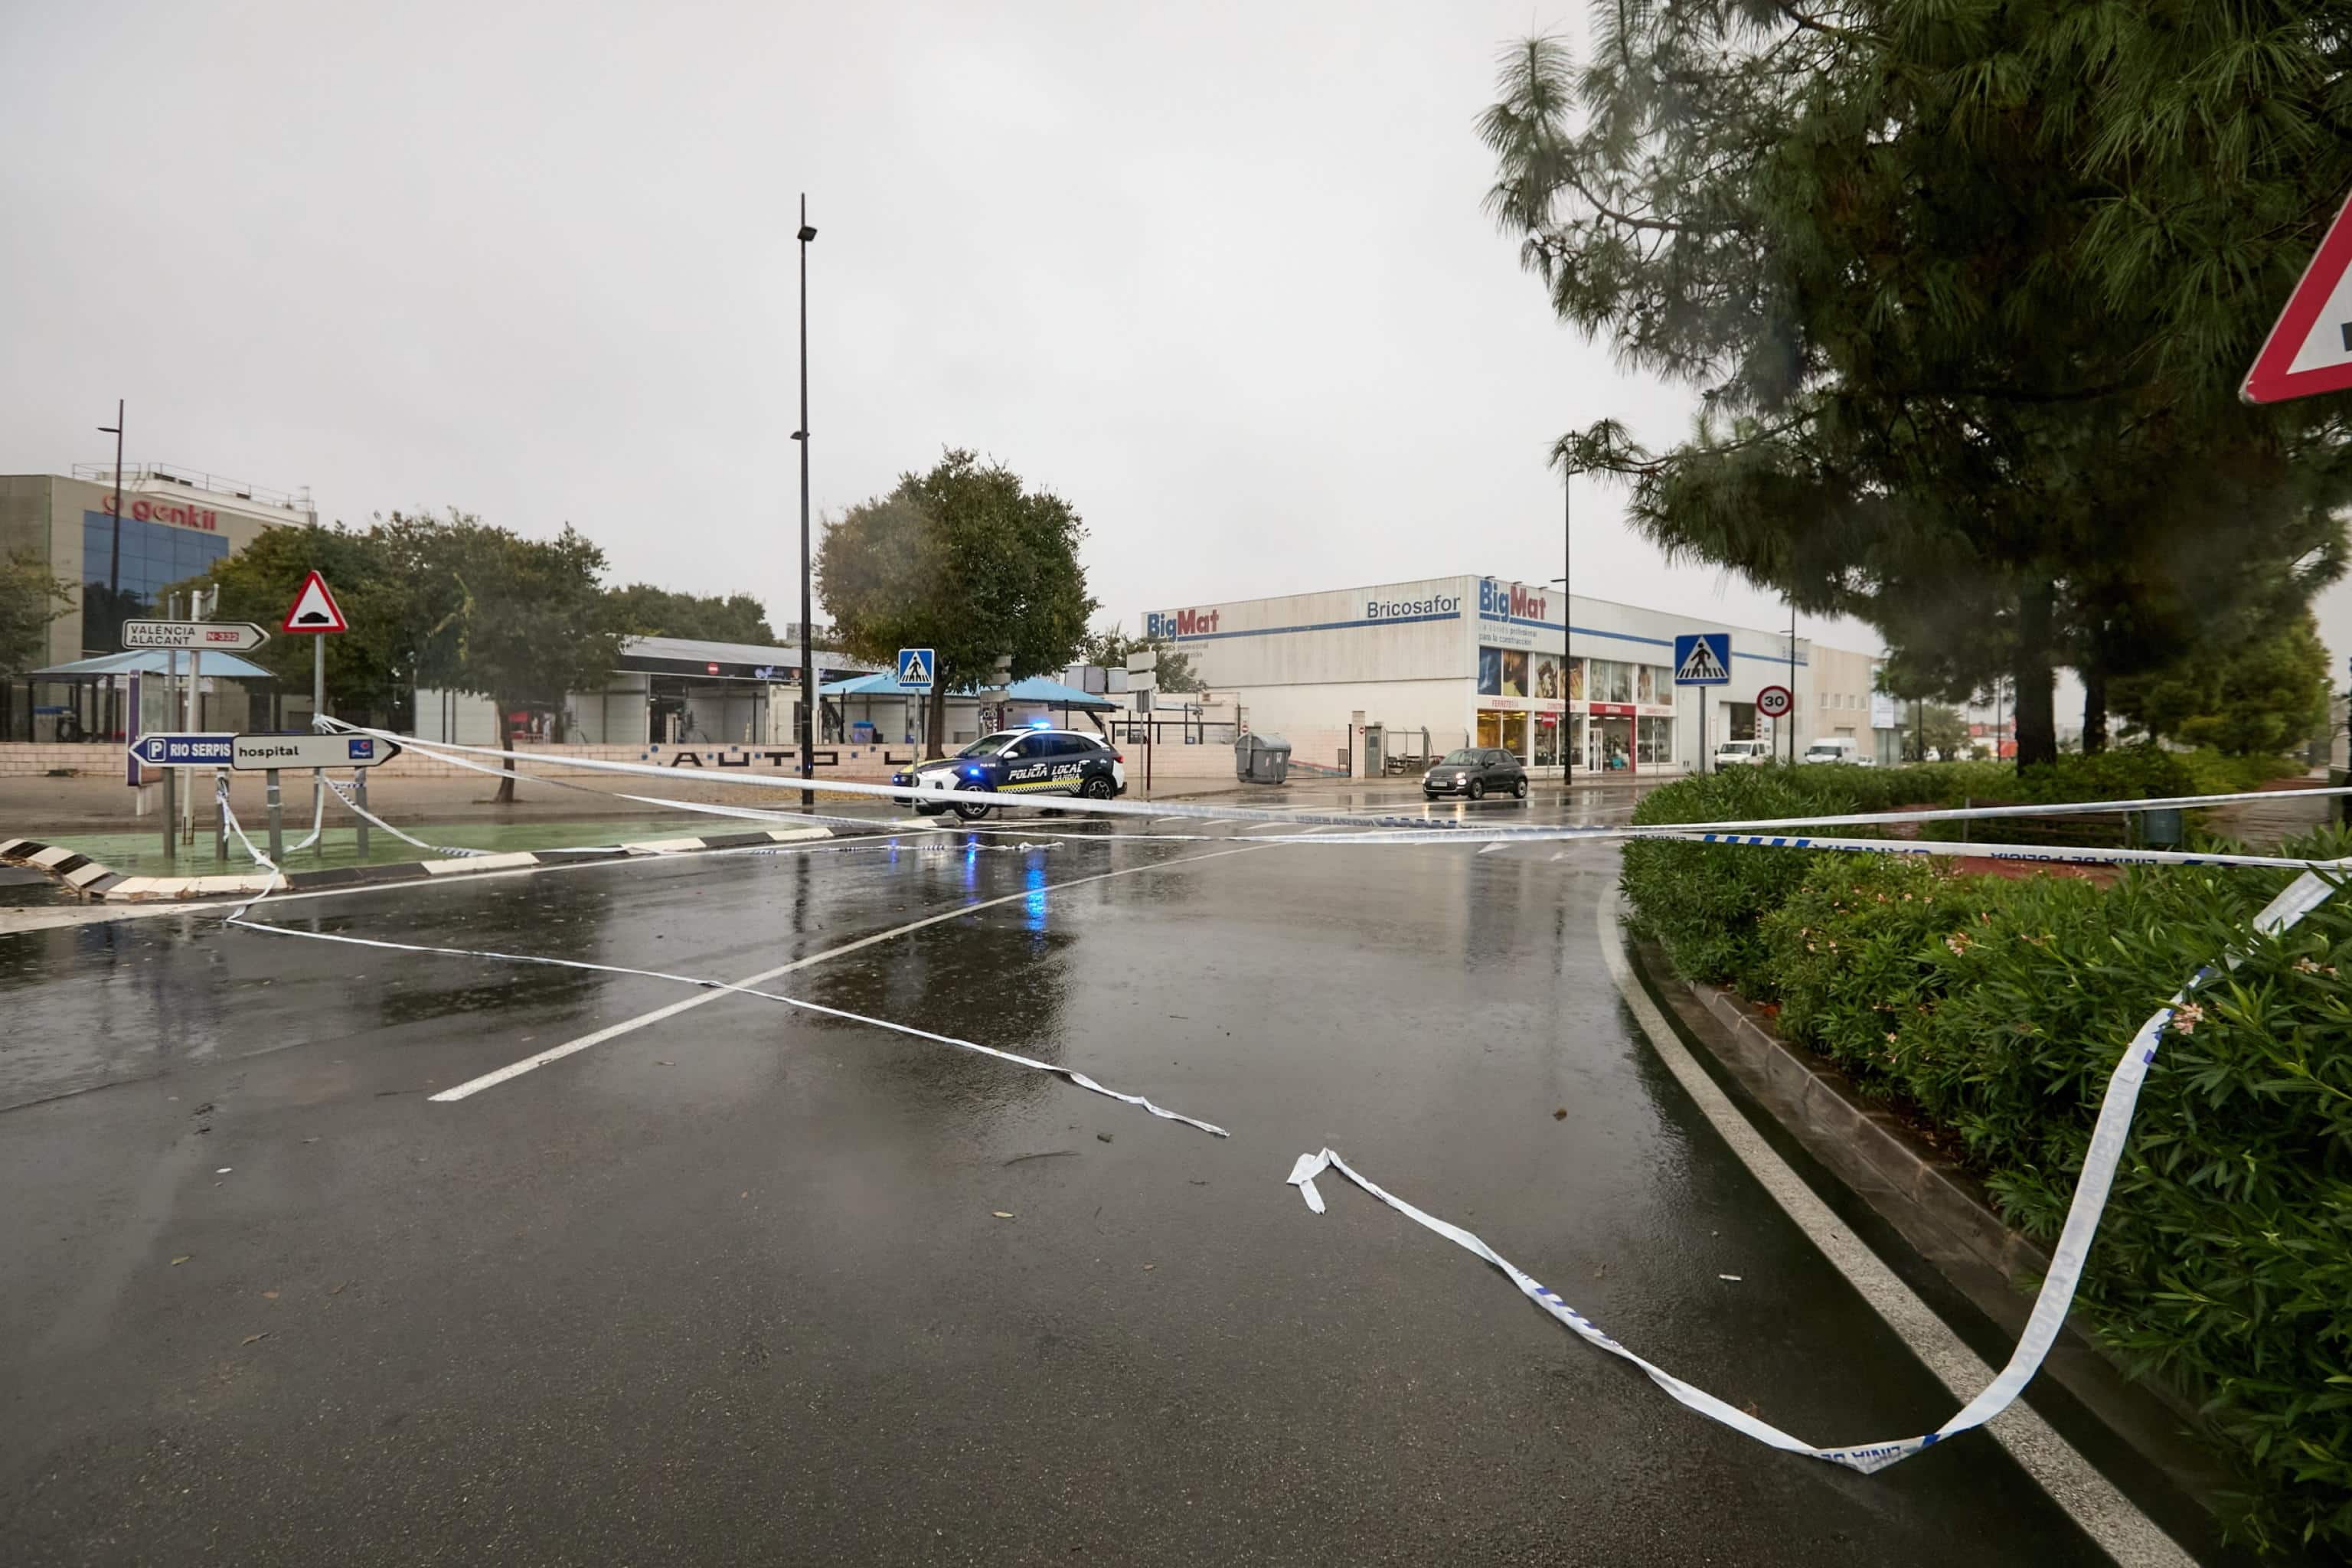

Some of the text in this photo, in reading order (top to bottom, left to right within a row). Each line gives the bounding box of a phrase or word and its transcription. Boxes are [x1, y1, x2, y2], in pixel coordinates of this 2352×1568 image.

[1367, 595, 1461, 618] Bricosafor
[1479, 580, 1546, 622] BigMat
[130, 624, 195, 635] VALÈNCIA
[1147, 609, 1219, 642] BigMat
[130, 635, 190, 645] ALACANT
[207, 632, 239, 642] N-332
[1764, 696, 1785, 707] 30
[152, 742, 162, 757] P
[170, 743, 230, 756] RIO SERPIS
[239, 745, 299, 759] hospital
[671, 752, 839, 767] AUTO
[1052, 764, 1083, 776] LOCAL
